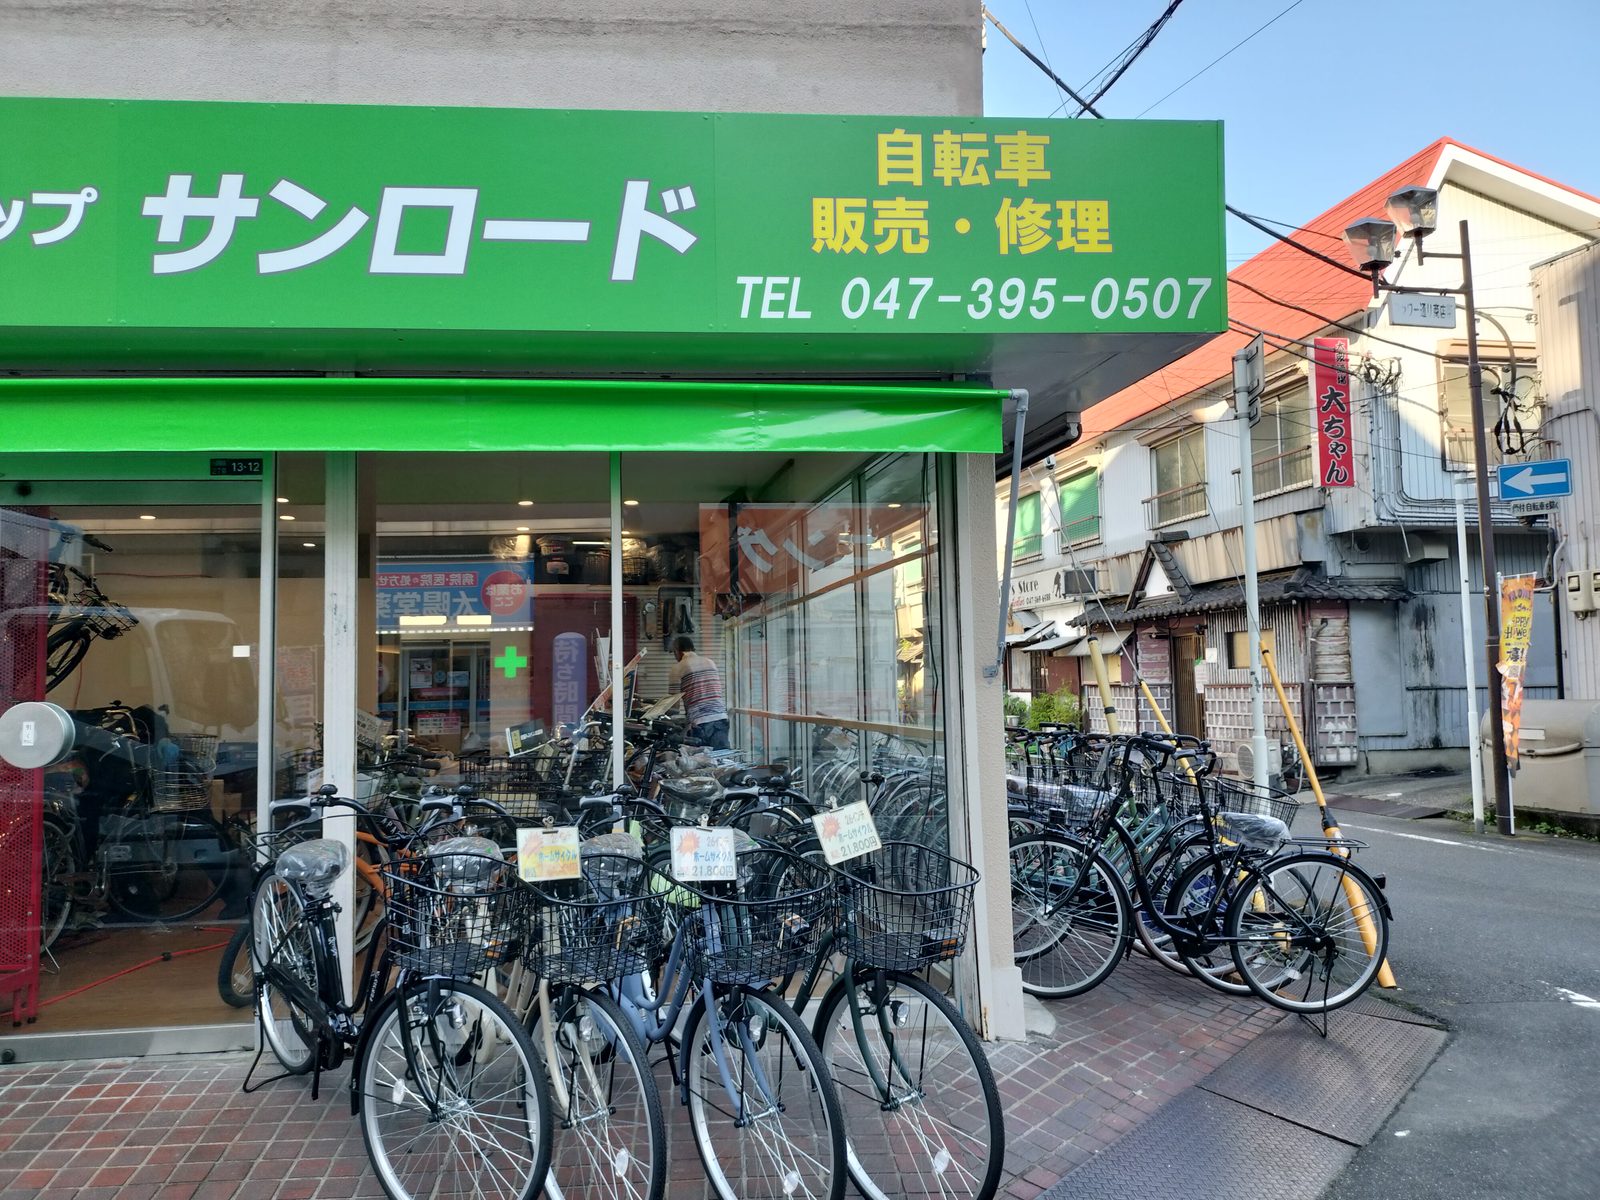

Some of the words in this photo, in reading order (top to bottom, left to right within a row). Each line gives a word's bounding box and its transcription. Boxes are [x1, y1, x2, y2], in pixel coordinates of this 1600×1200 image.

[876, 128, 1052, 187] 自転車
[142, 173, 698, 281] サンロード
[811, 196, 1114, 255] 販売・修理
[736, 276, 812, 319] TEL
[840, 277, 1212, 319] 047-395-0507
[1321, 386, 1348, 484] 大ちゃん
